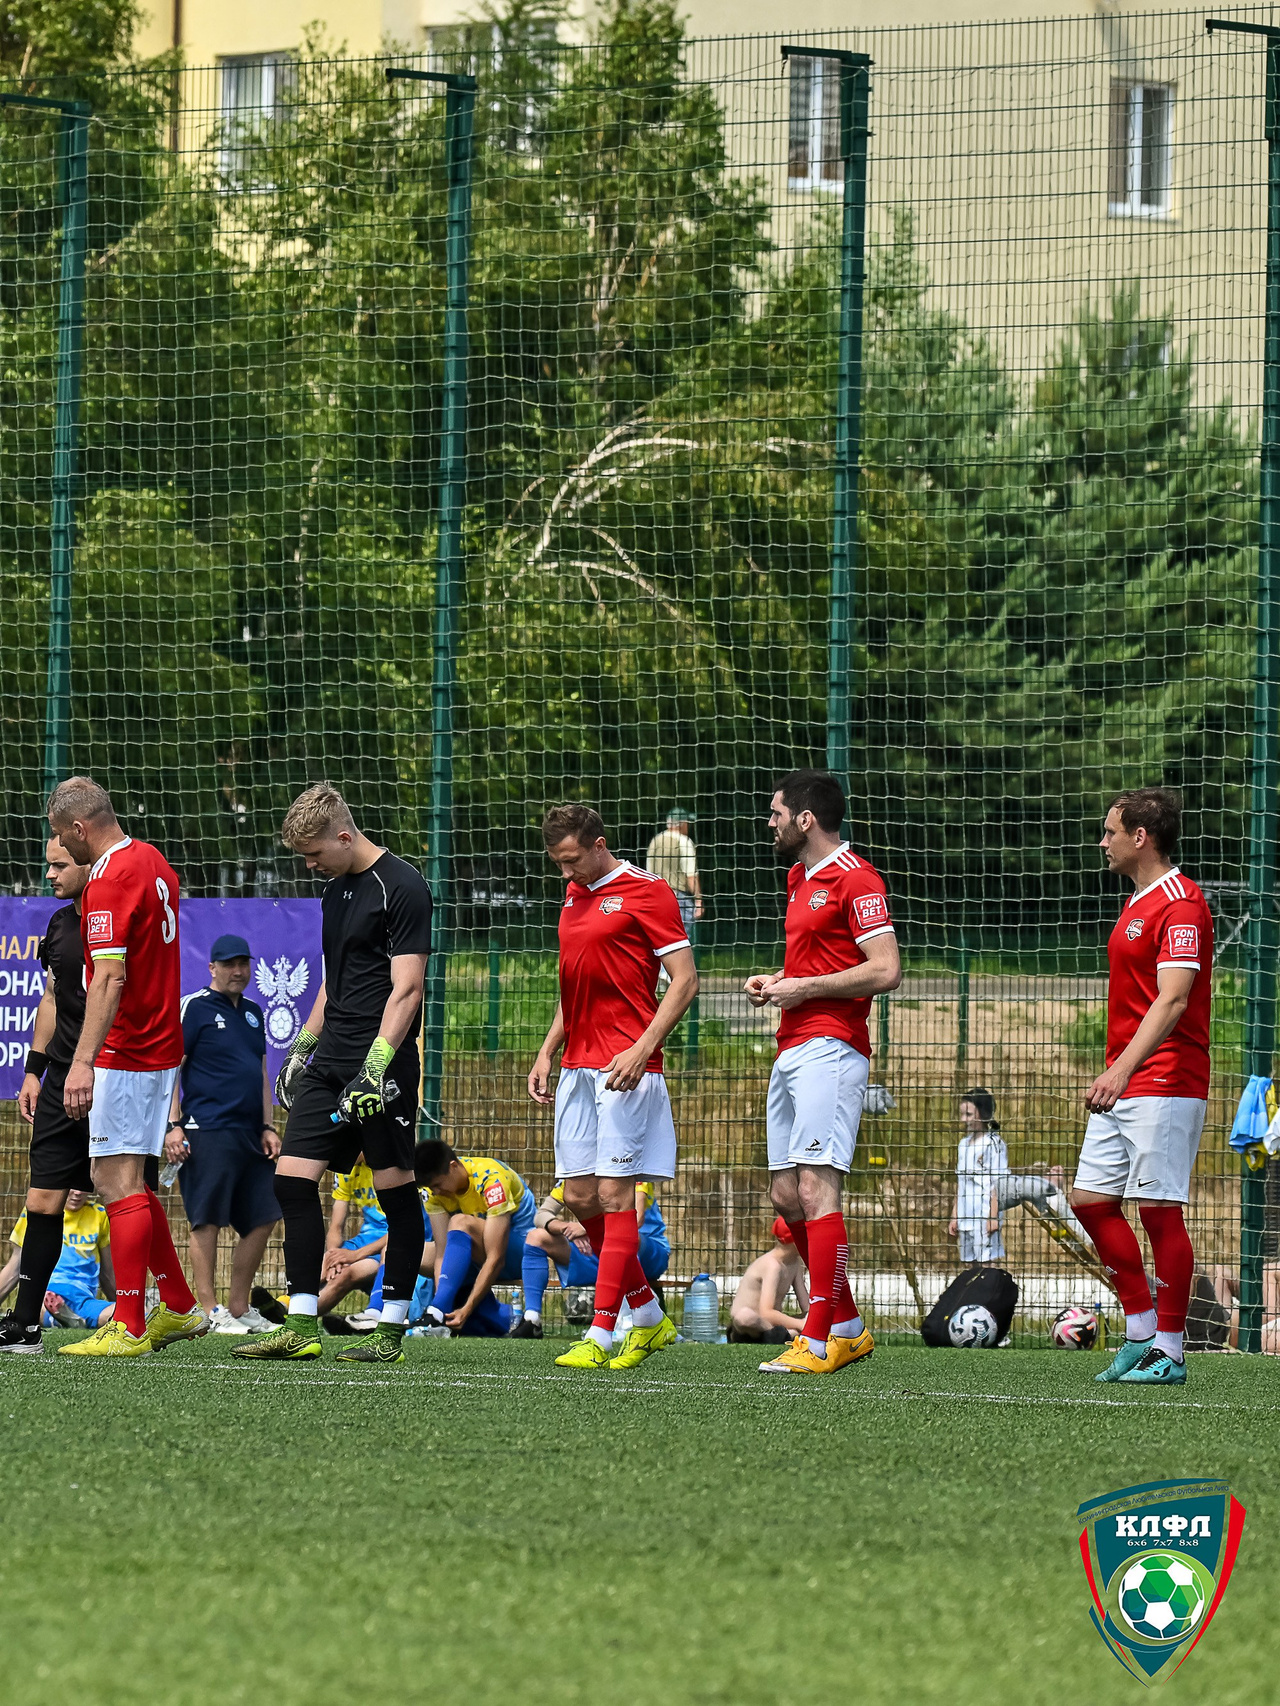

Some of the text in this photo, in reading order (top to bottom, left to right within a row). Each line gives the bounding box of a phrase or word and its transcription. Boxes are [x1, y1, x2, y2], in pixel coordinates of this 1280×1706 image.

[860, 897, 881, 910] FON
[155, 877, 176, 944] 3
[862, 906, 882, 918] BET
[90, 915, 108, 926] FON
[90, 923, 108, 934] BET
[1173, 929, 1194, 938] FON
[1174, 938, 1194, 947] BET
